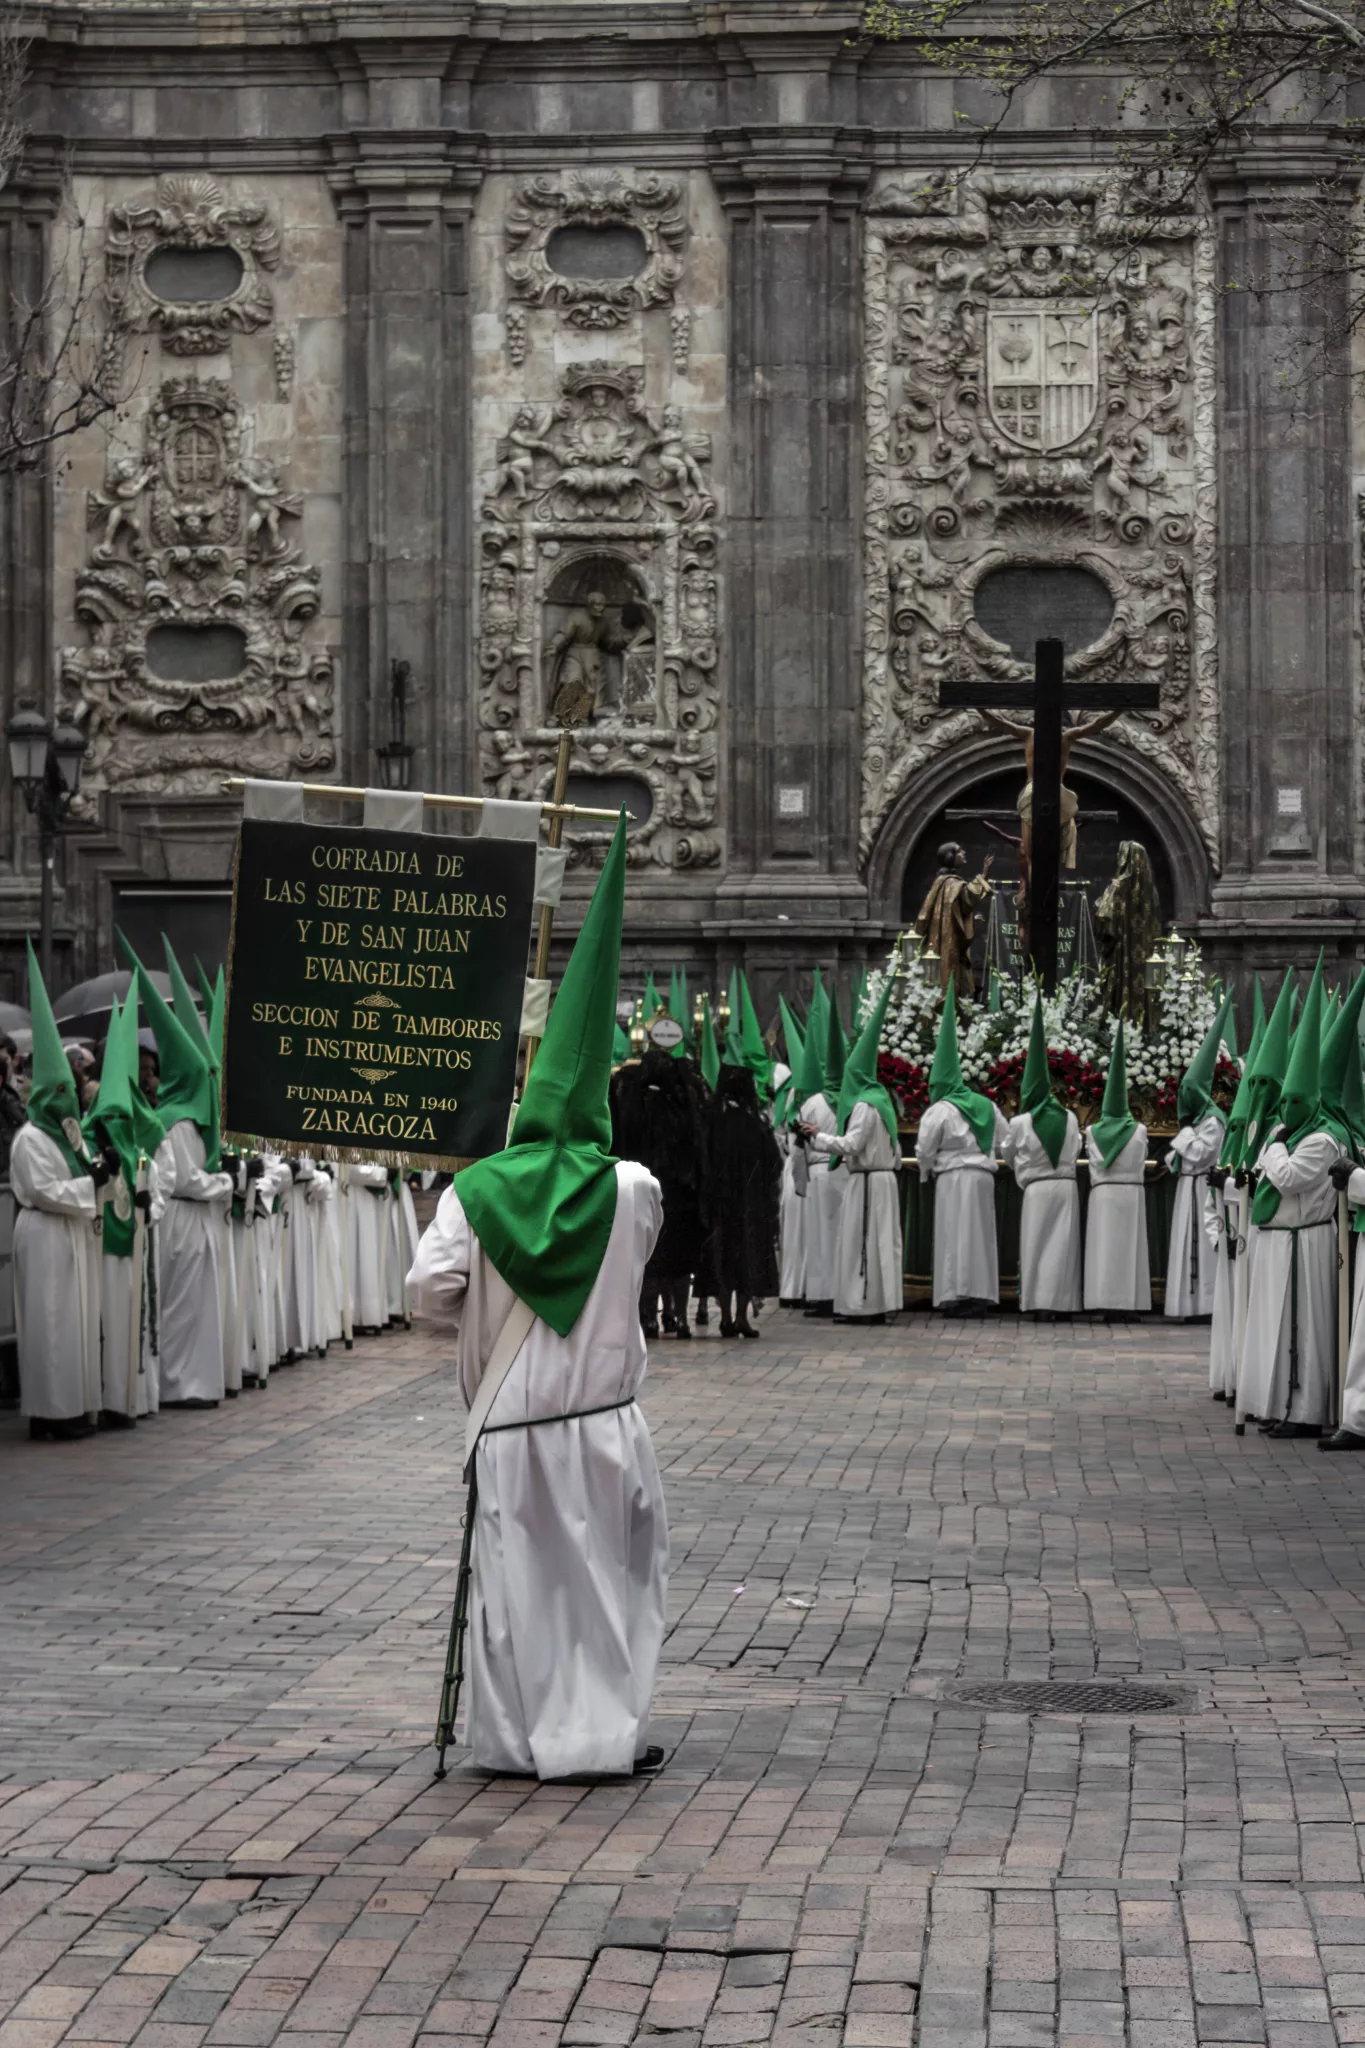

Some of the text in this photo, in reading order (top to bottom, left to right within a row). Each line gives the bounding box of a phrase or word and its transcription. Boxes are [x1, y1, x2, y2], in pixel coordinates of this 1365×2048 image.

[312, 846, 464, 877] COFRADIA DE
[264, 878, 506, 918] LAS SIETE PALABRAS
[297, 920, 470, 954] Y DE SAN JUAN
[305, 957, 455, 989] EVANGELISTA
[252, 1003, 501, 1040] SECCION DE TAMBORES
[278, 1036, 471, 1069] E INSTRUMENTOS
[286, 1085, 457, 1111] FUNDADA EN 1940
[302, 1108, 437, 1140] ZARAGOZA
